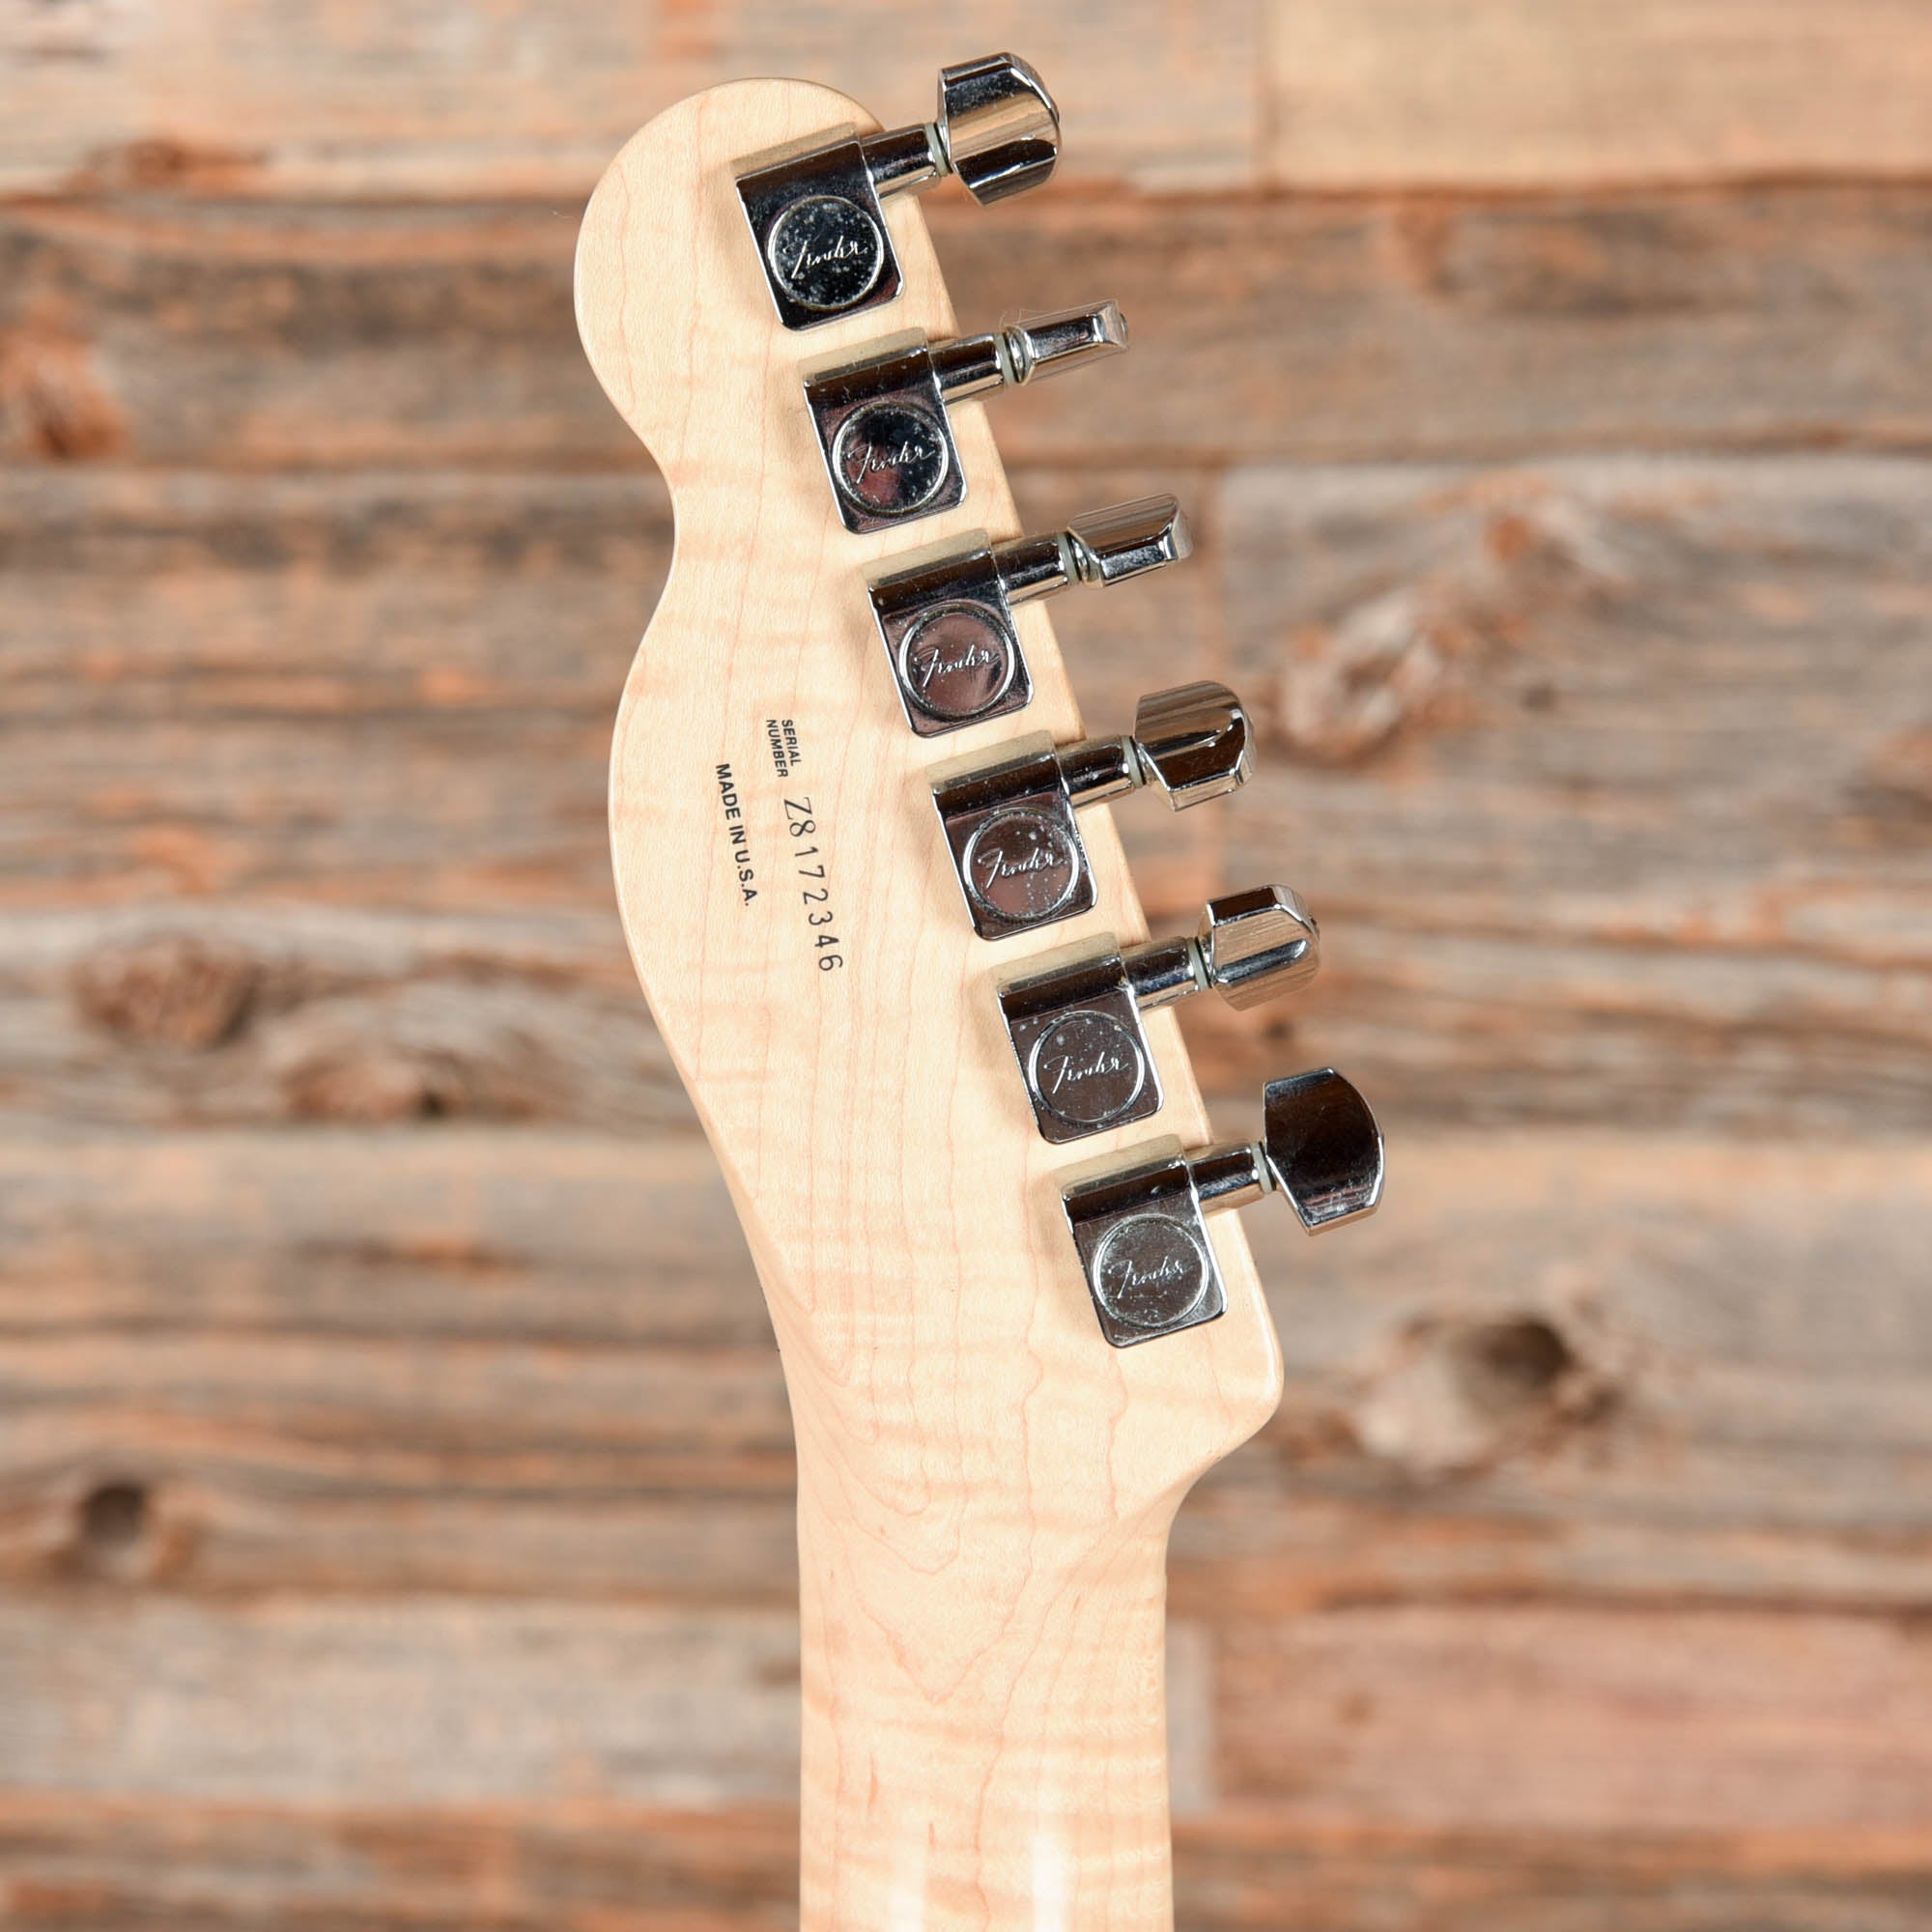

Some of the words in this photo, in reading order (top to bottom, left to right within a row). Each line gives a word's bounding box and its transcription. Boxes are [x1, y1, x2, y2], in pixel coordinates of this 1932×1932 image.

[782, 235, 869, 279] Fender
[846, 440, 936, 484] Fender
[913, 643, 999, 688] Fender
[766, 719, 788, 778] NUMBER
[781, 719, 802, 766] SERIAL
[715, 763, 741, 820] MADE
[728, 825, 747, 845] IN
[734, 849, 758, 907] U.S.A.
[783, 796, 843, 971] Z8172346
[977, 846, 1065, 890] Fender
[1043, 1051, 1129, 1094] Fender
[1107, 1255, 1189, 1299] Fender
